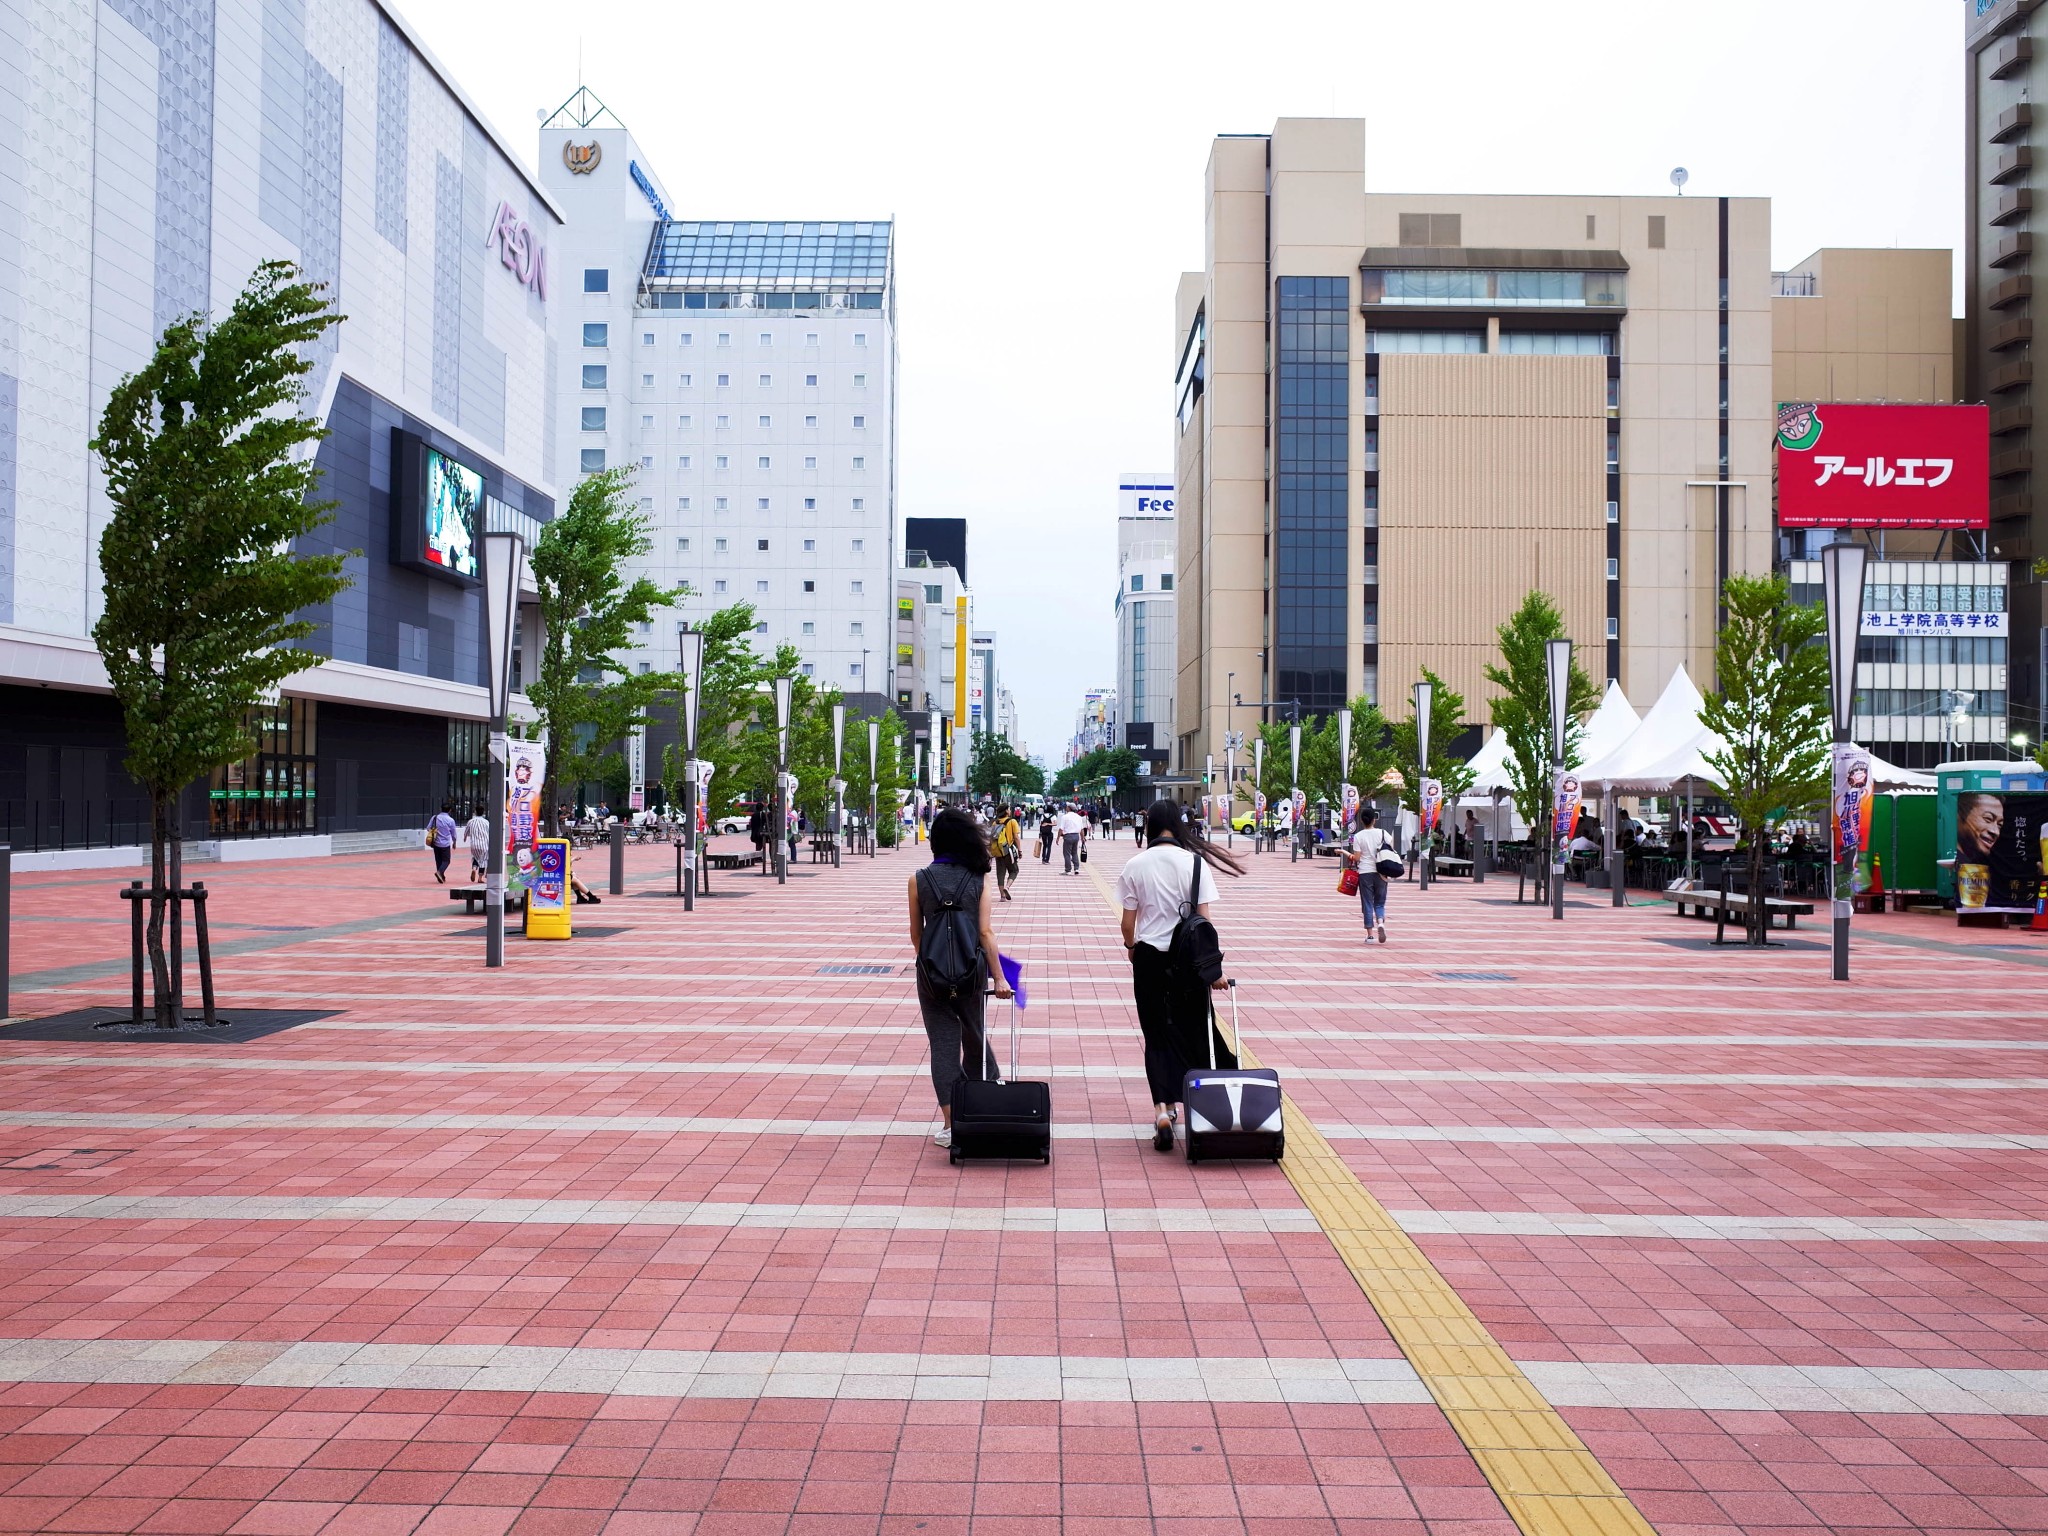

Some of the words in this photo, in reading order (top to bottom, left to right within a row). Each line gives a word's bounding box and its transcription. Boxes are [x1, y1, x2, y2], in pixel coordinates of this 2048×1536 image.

[1813, 455, 1953, 488] アールエフ
[1866, 613, 2000, 628] 池上学院高等学校
